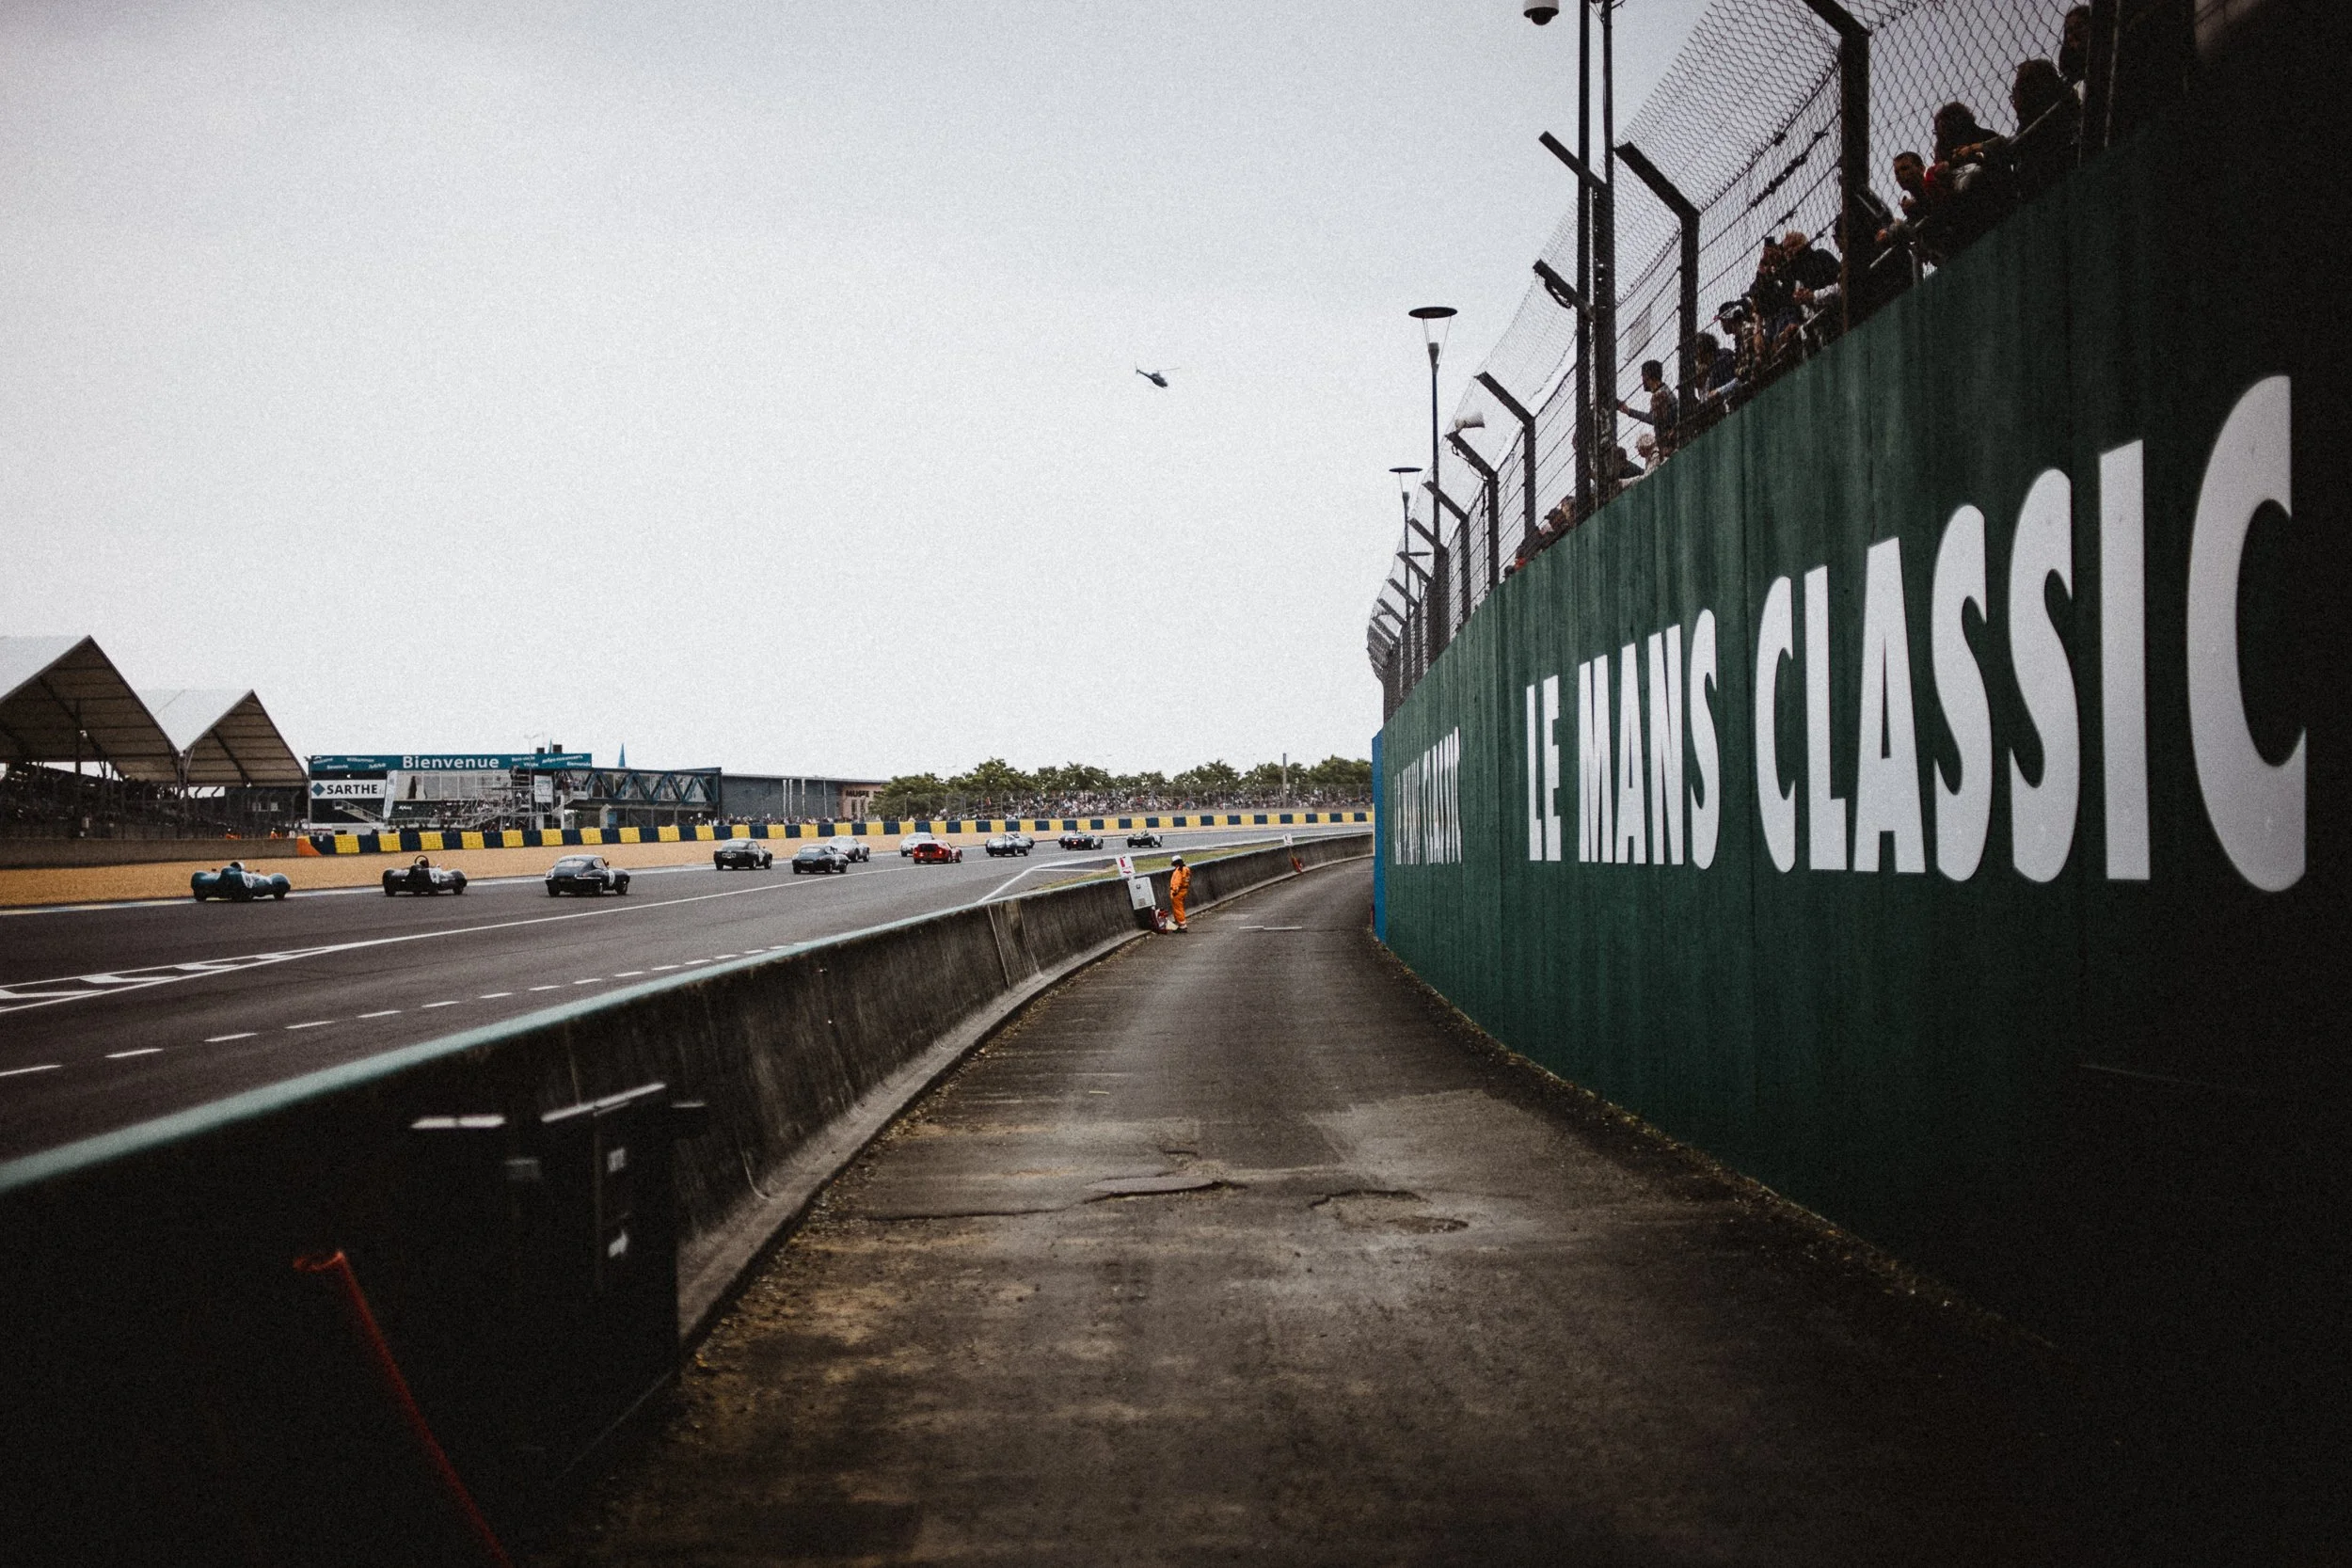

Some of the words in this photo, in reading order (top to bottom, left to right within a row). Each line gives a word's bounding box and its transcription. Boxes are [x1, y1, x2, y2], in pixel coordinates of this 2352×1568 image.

[1527, 674, 1561, 862] LE
[1579, 609, 1720, 870] MANS
[1756, 374, 2307, 893] CLASSIC
[326, 784, 378, 795] SARTHE
[403, 755, 500, 768] Bienvenue
[1422, 726, 1462, 865] CLASSIC
